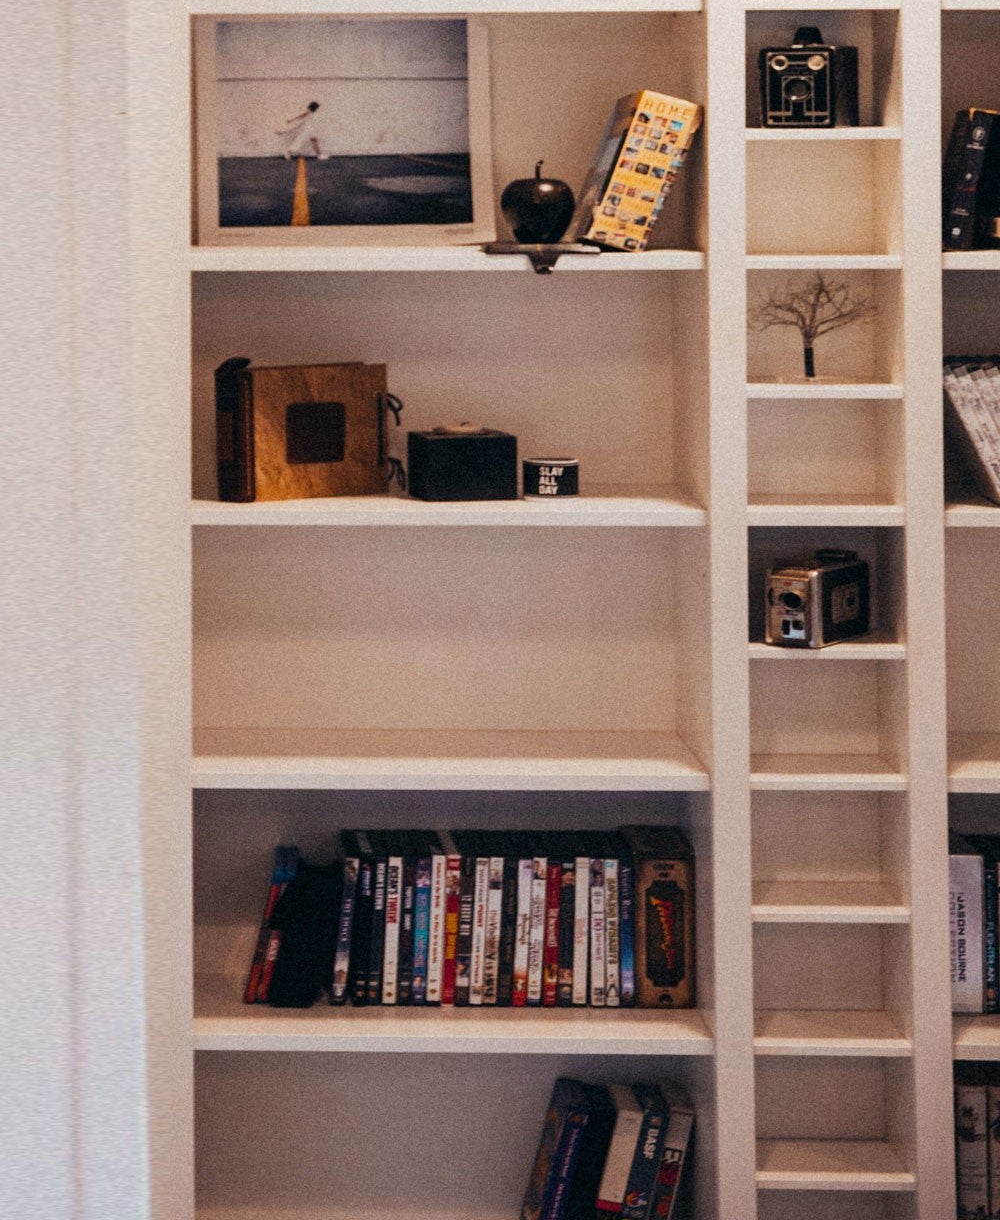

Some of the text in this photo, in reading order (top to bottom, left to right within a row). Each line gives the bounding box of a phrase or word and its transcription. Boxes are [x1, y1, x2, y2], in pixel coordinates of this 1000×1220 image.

[643, 98, 693, 120] HOME
[539, 466, 564, 476] SLAY
[539, 476, 558, 485] ALL
[538, 485, 558, 495] DAY
[375, 862, 385, 910] OCEAN'S ELEVEN
[387, 865, 400, 924] OCEAN'S TWELVE
[957, 895, 966, 982] JASON BOURNE
[643, 1128, 660, 1160] BASF
